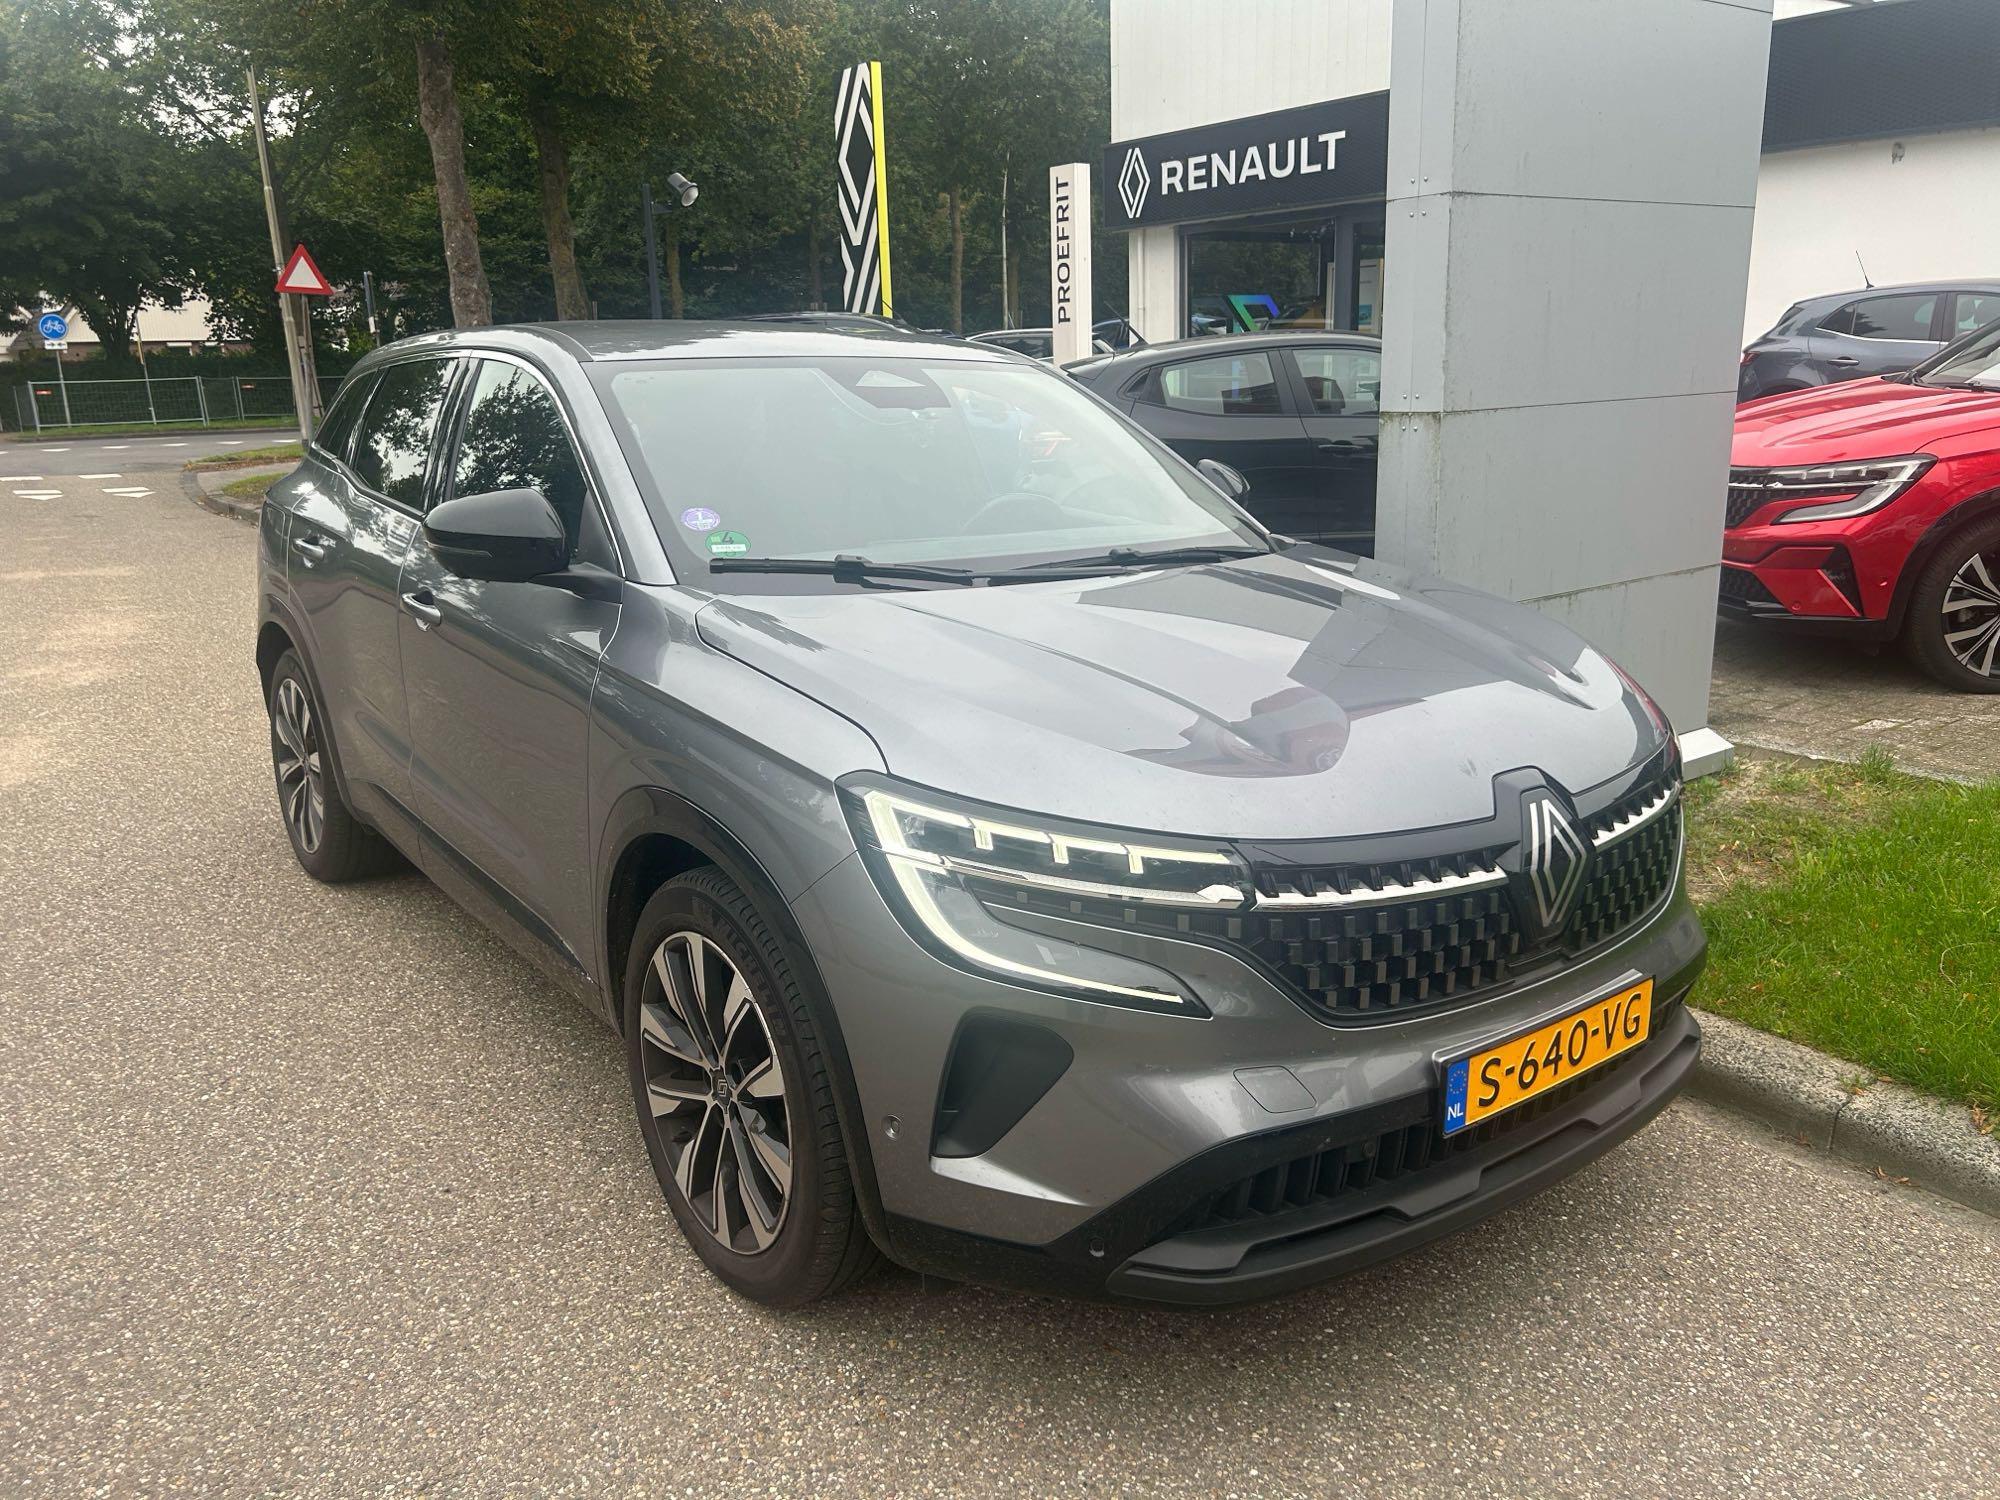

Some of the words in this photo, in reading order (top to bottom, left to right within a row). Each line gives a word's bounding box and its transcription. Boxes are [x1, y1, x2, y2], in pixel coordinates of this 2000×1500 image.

[1160, 130, 1346, 195] RENAULT
[1055, 176, 1071, 324] PROEFRIT
[1478, 992, 1642, 1108] S-640-VG
[1447, 1102, 1464, 1121] NL
